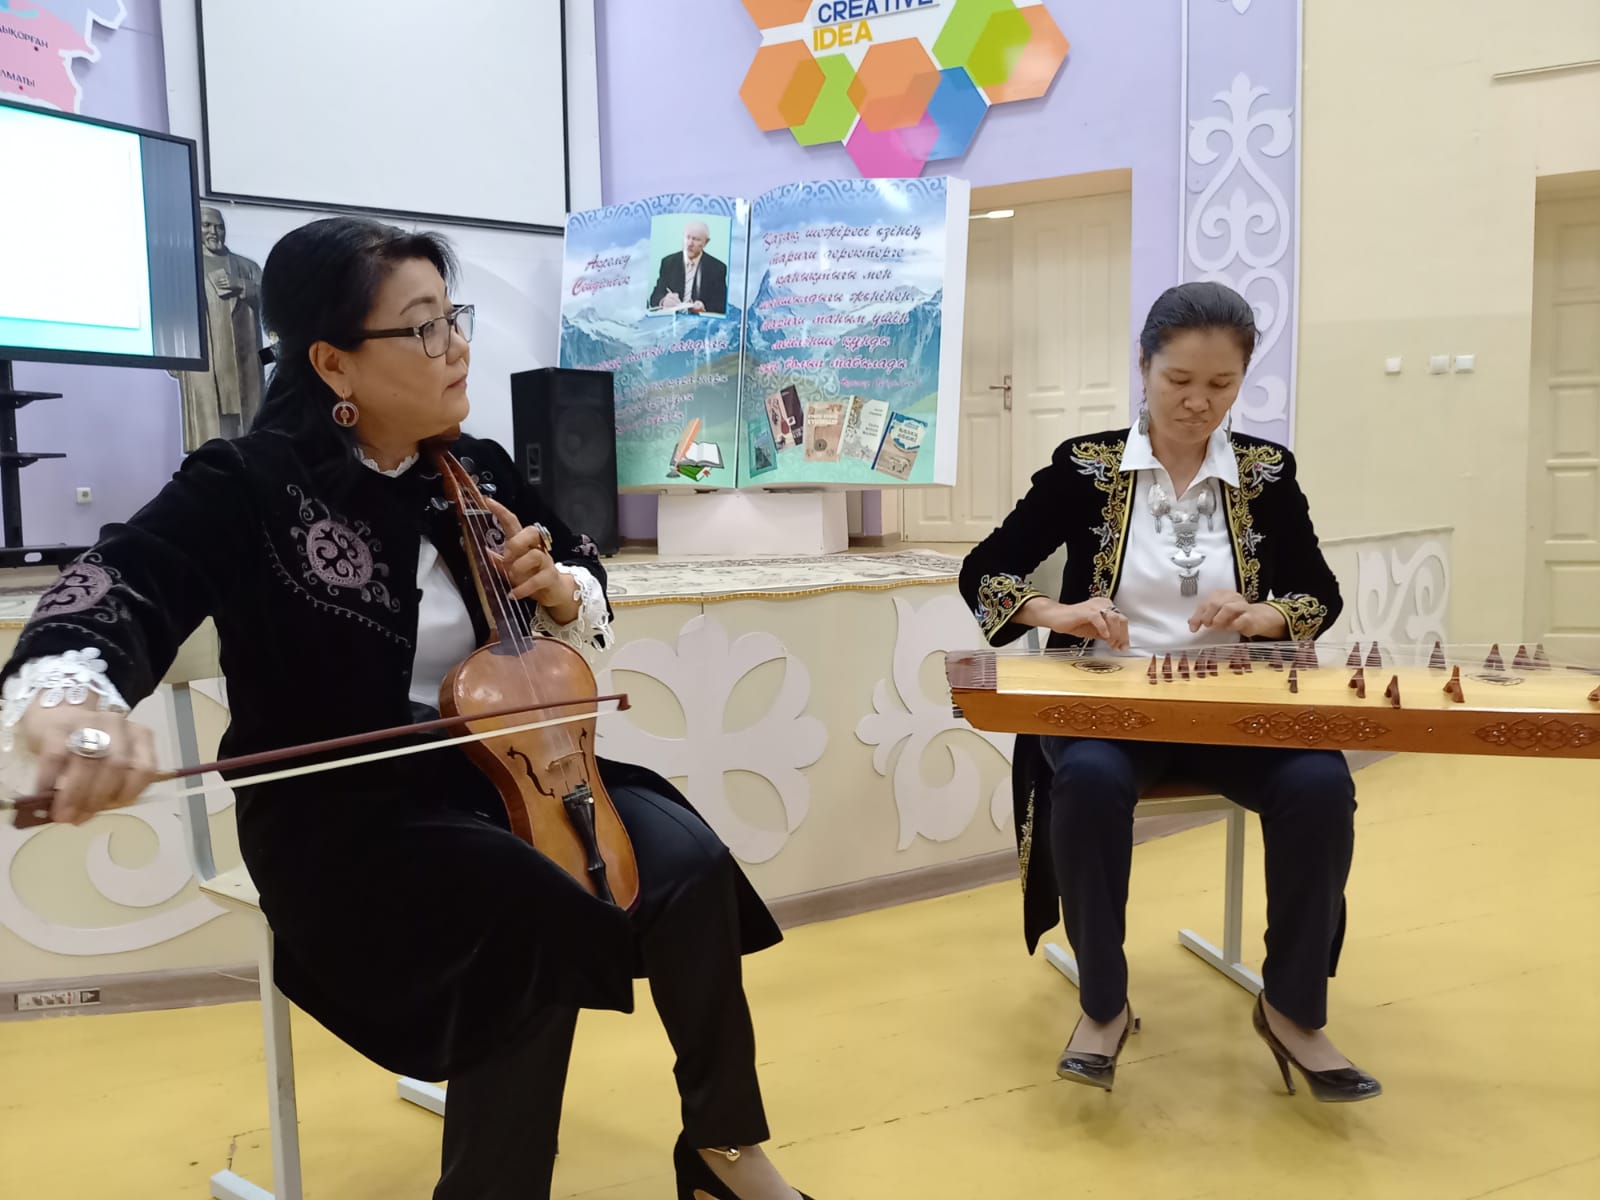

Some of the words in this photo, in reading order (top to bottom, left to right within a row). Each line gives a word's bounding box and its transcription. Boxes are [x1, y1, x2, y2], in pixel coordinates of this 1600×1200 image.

[818, 0, 933, 23] CREATI
[813, 19, 873, 51] IDEA
[863, 269, 892, 280] мен
